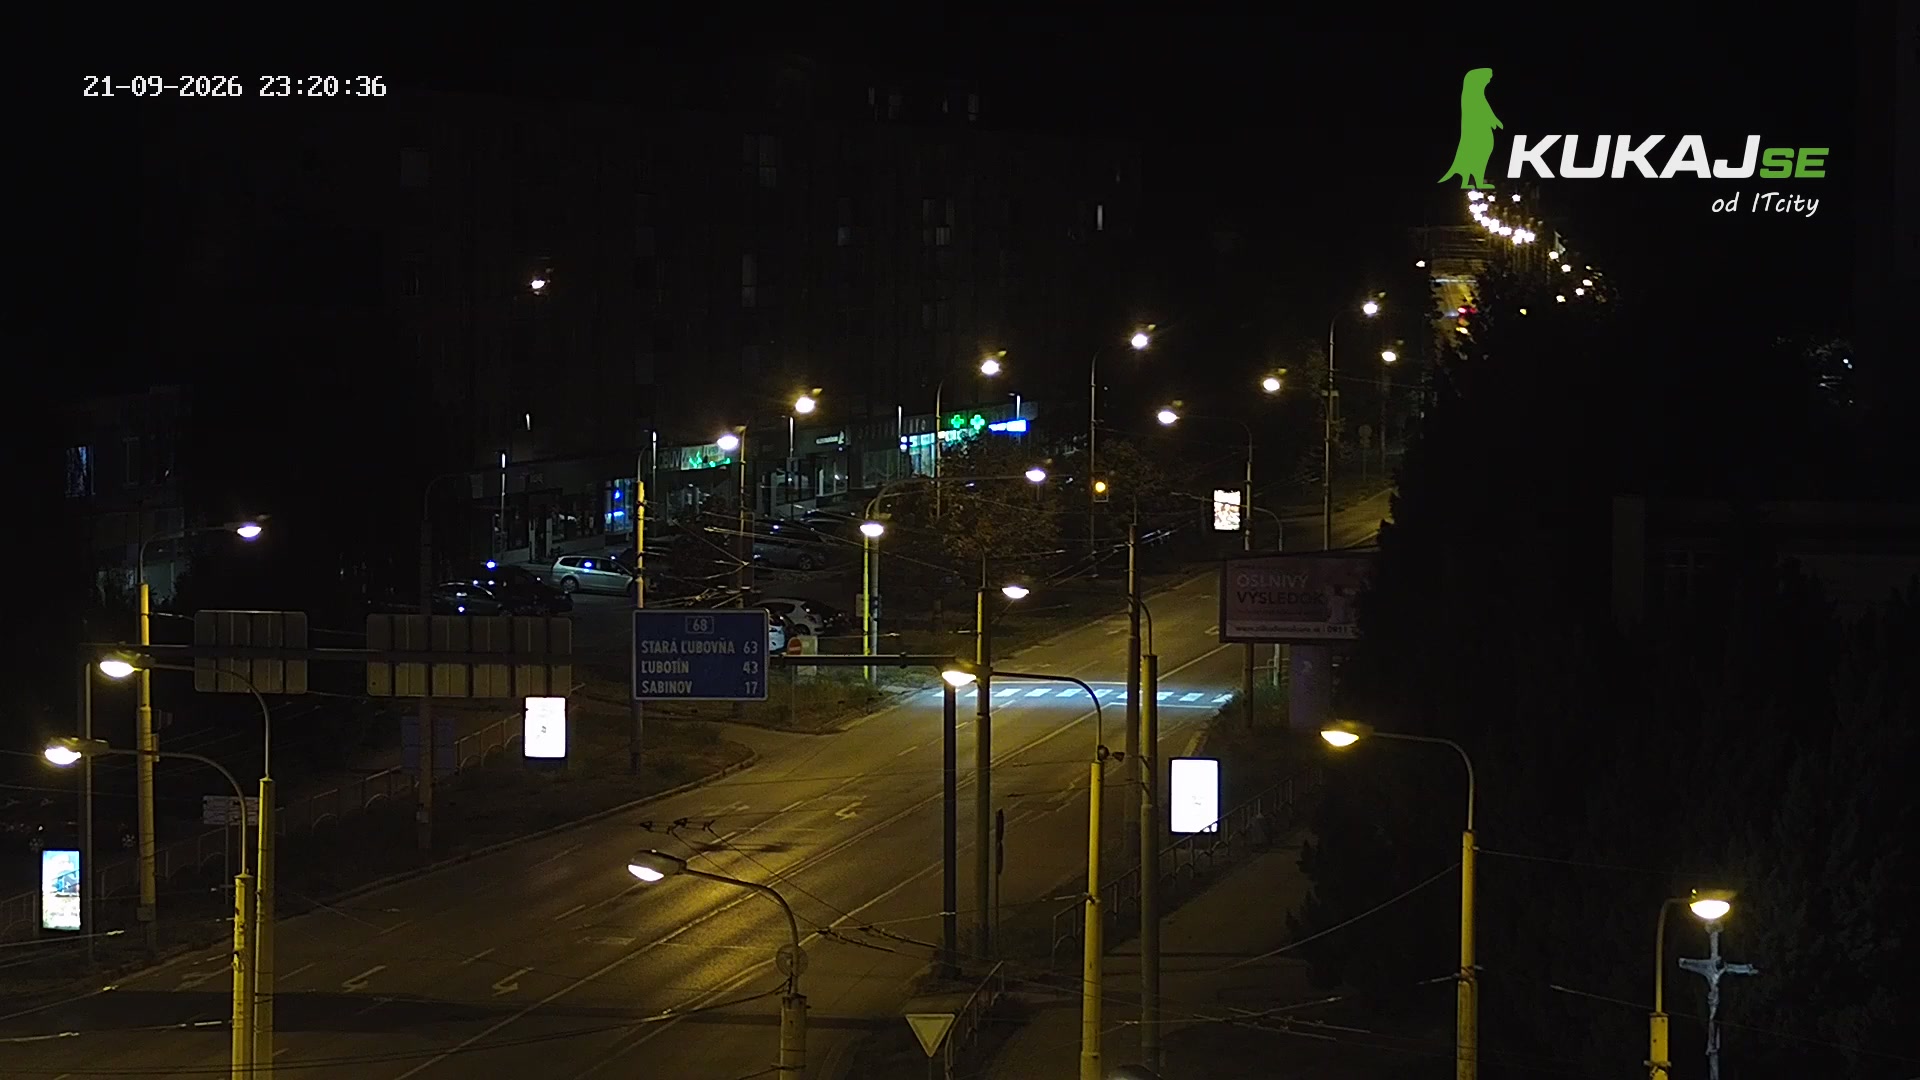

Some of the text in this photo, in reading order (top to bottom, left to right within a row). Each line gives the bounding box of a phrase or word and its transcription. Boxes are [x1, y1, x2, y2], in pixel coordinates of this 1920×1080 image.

[692, 618, 708, 632] 68
[641, 637, 758, 654] STARÁ ĽUBOVŇA 63
[641, 658, 759, 674] ĽUBOTÍN 43
[641, 680, 758, 694] SABINOV 17
